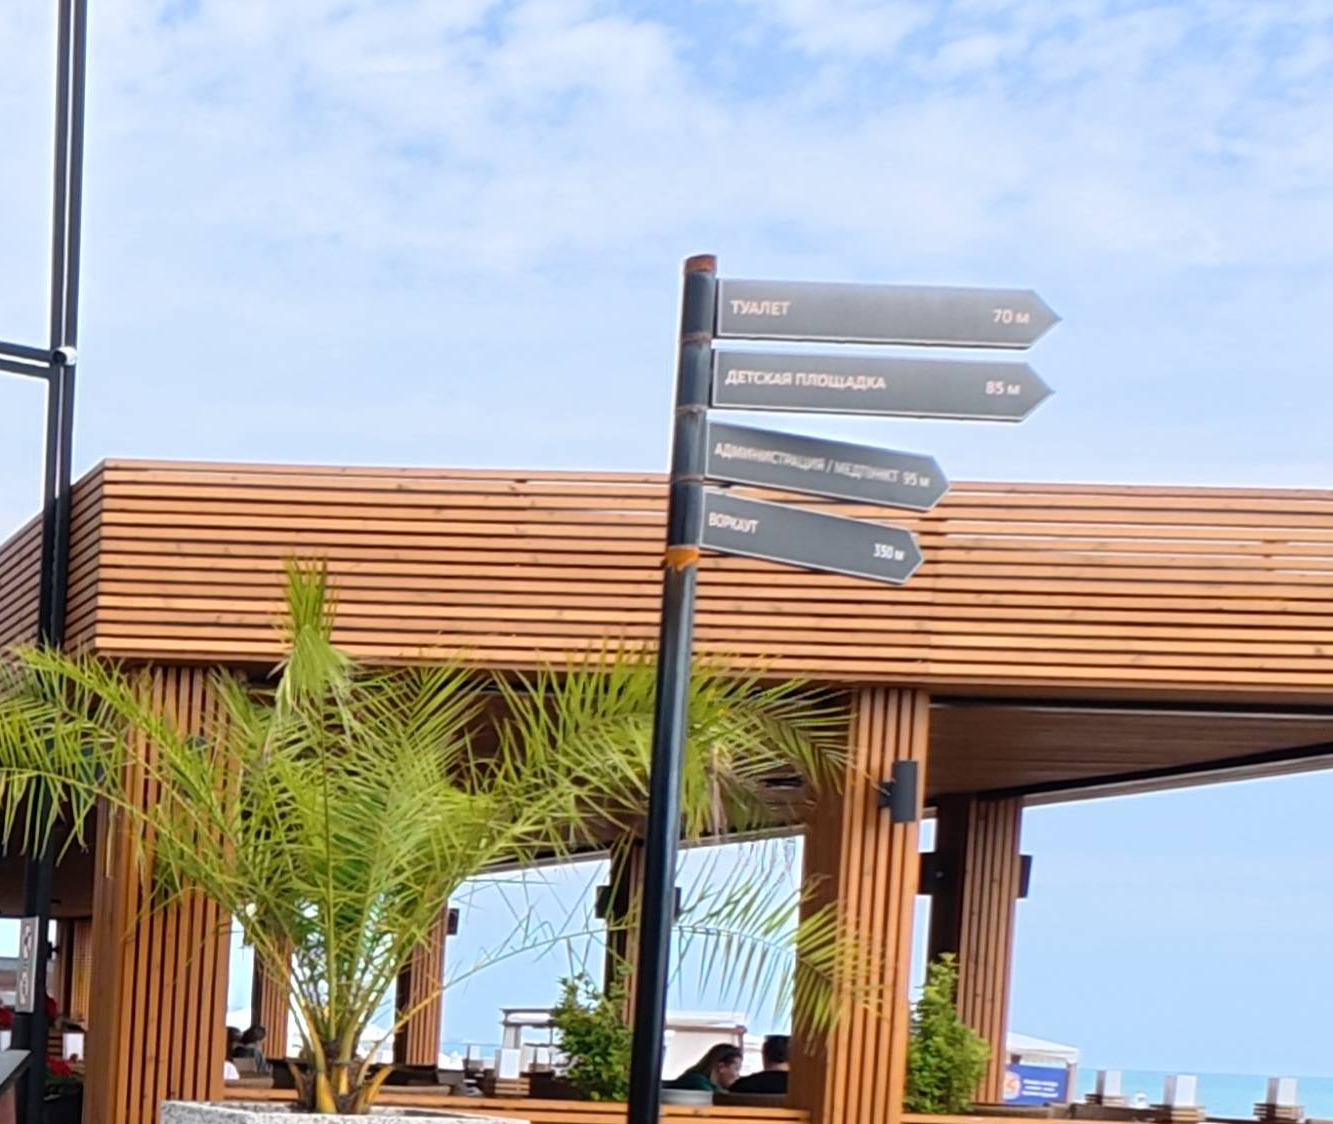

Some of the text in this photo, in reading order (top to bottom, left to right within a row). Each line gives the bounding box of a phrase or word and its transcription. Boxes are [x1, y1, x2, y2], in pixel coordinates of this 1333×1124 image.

[731, 299, 791, 317] ТУАЛЕТ
[992, 308, 1013, 325] 70
[725, 369, 887, 391] ДЕТСКАЯ ПЛОЩАДКА
[985, 381, 1005, 396] 85
[714, 442, 825, 473] АДМИНИСТРАЦИЯ
[902, 471, 918, 486] 95
[708, 512, 760, 534] ВОРКАУТ
